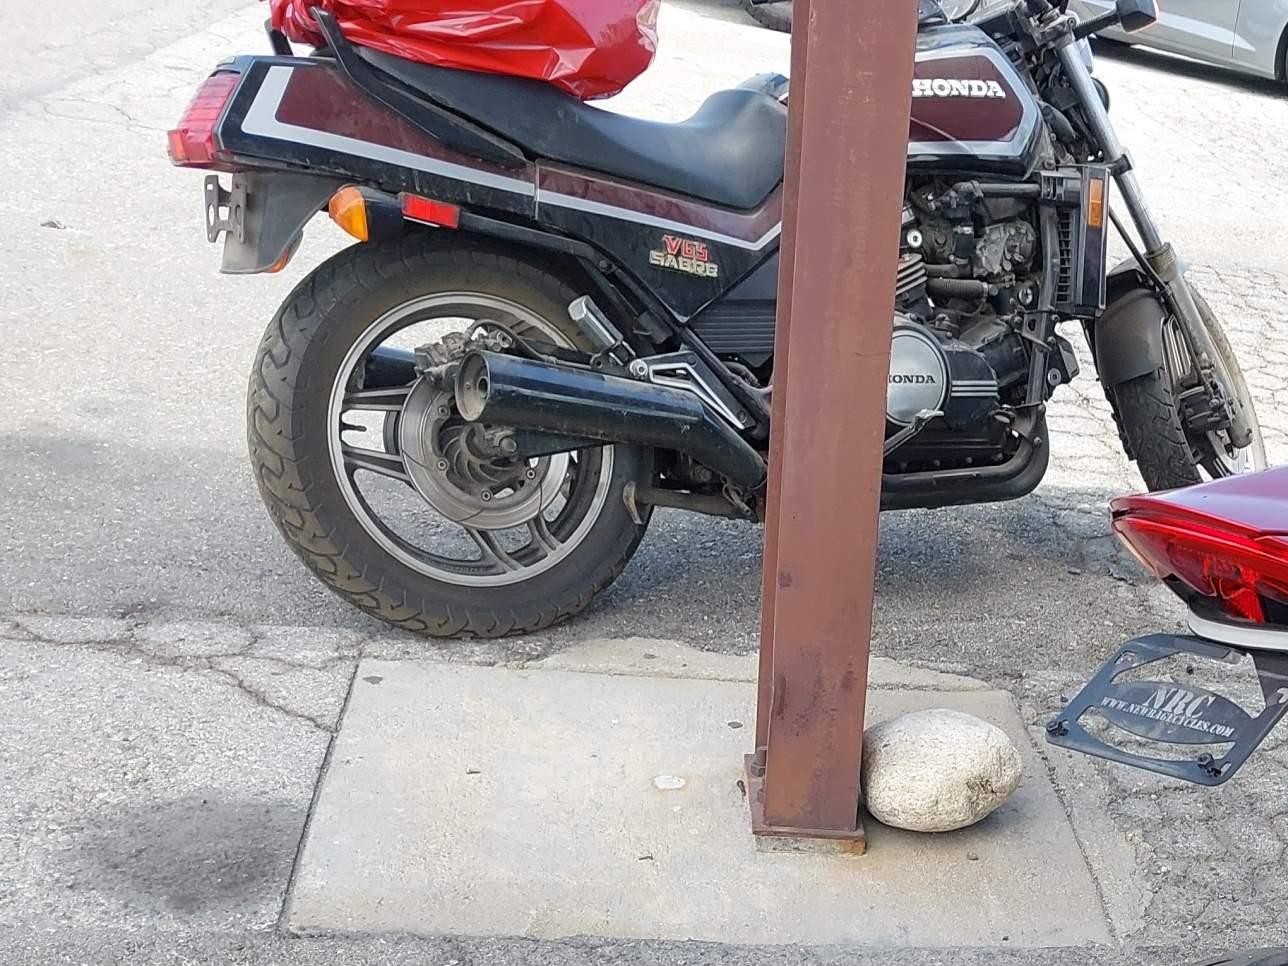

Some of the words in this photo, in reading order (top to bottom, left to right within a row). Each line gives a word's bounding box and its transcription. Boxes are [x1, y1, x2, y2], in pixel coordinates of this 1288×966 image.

[912, 79, 1006, 98] HONDA
[661, 235, 708, 261] V65
[648, 250, 719, 277] SABRE
[1141, 687, 1216, 718] NRC
